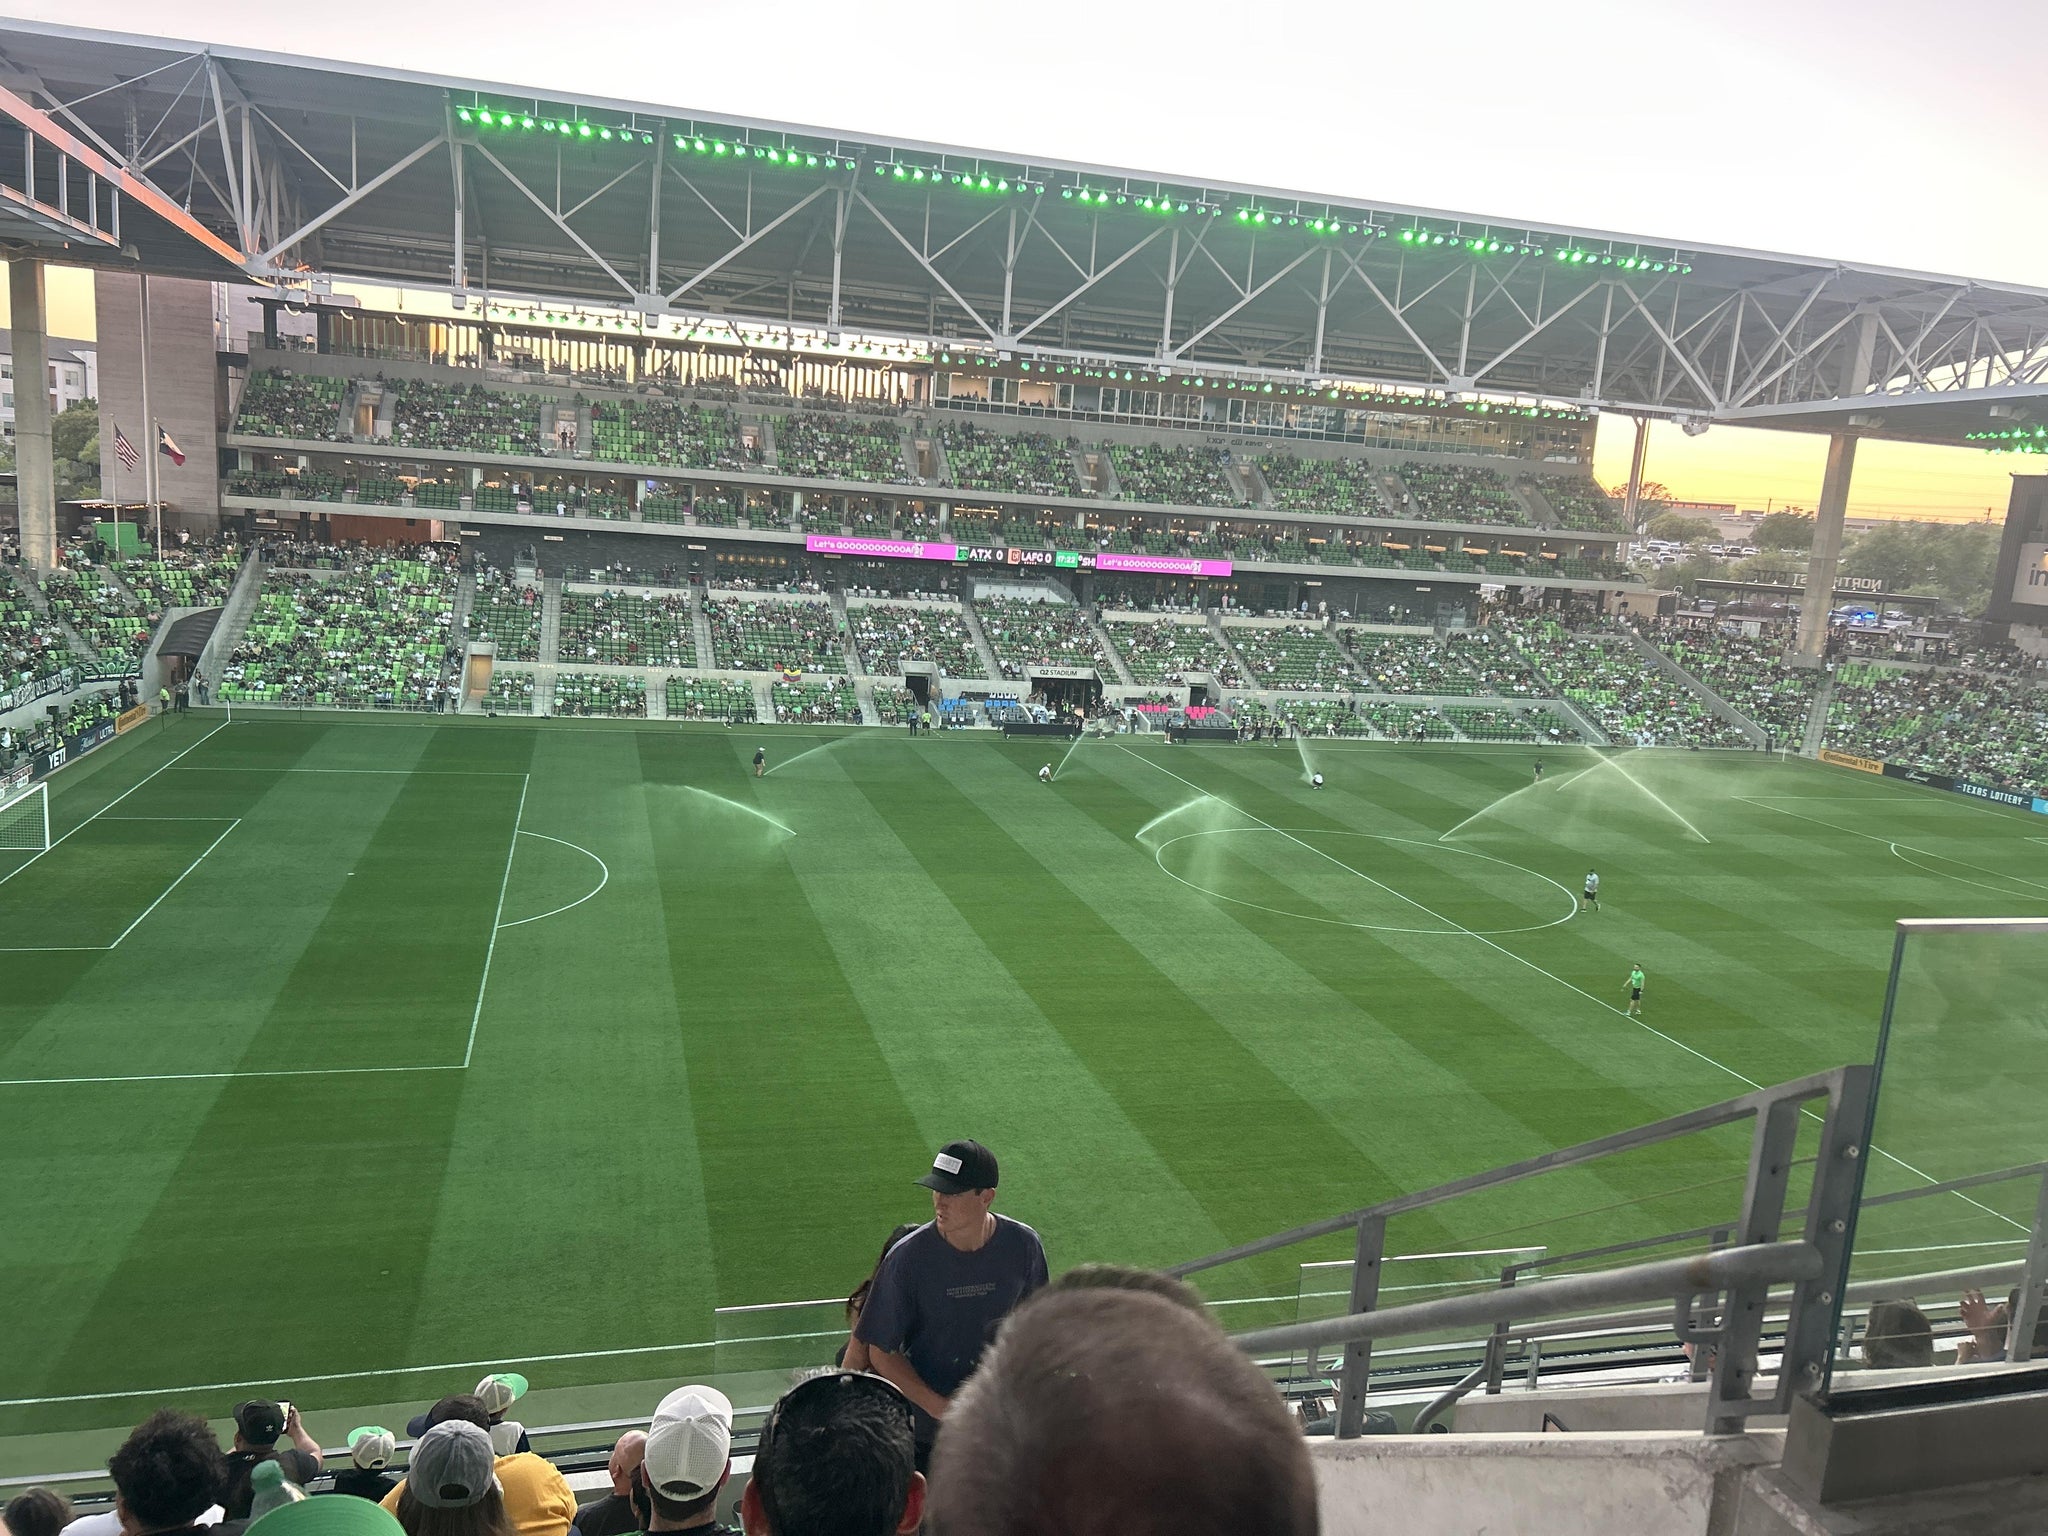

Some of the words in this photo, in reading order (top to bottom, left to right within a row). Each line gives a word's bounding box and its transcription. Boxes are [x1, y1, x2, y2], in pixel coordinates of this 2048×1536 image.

[814, 540, 835, 549] Let's
[969, 548, 992, 560] ATX
[995, 549, 1004, 561] 0
[1021, 551, 1043, 563] LAFC
[1044, 553, 1052, 564] 0
[1103, 558, 1122, 567] Let's
[1039, 668, 1050, 676] Q2
[1049, 669, 1078, 677] STADIUM
[48, 746, 67, 770] YETI
[1863, 759, 1880, 771] Tire
[1962, 783, 1988, 797] TEXAS
[1990, 791, 2025, 806] LOTTERY
